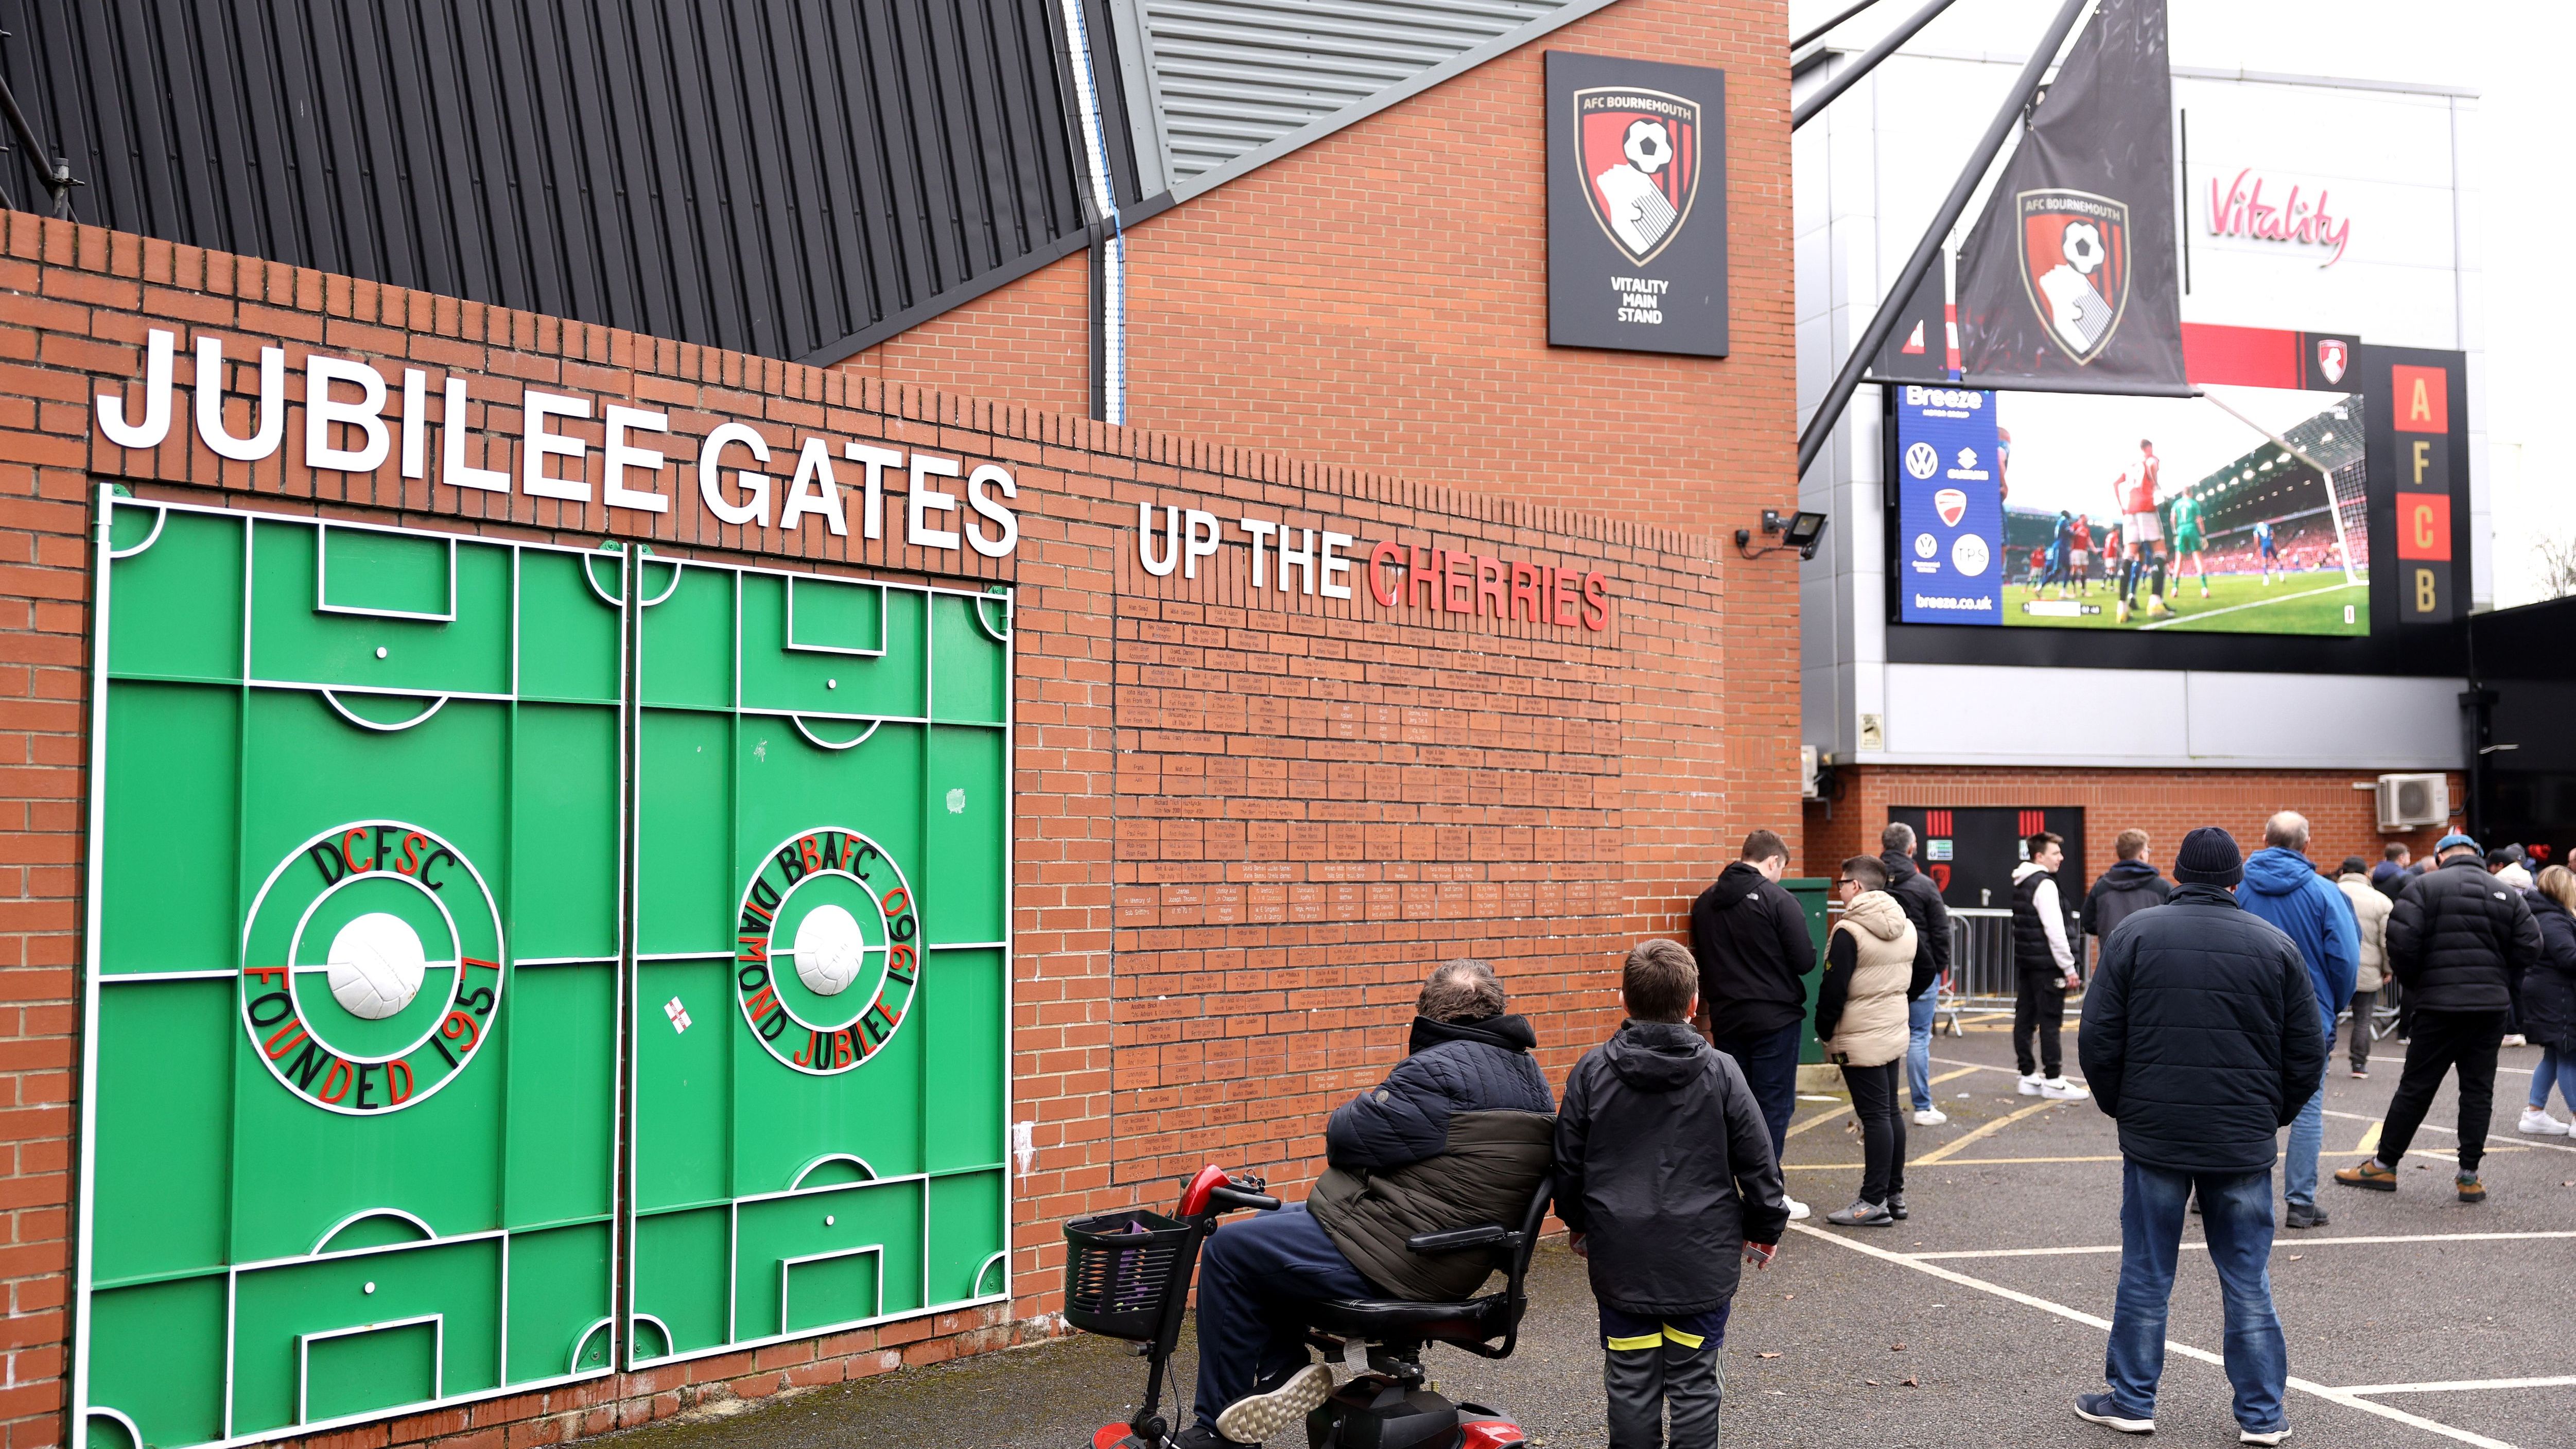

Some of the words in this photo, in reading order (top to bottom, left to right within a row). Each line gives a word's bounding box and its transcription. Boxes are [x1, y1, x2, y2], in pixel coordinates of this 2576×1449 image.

[1583, 96, 1605, 110] AFC
[1607, 96, 1692, 120] BOURNEMOUTH
[2026, 199, 2045, 212] AFC
[2046, 198, 2120, 221] BOURNEMOUTH
[2213, 167, 2349, 267] Vitality
[1611, 276, 1669, 294] VITALITY
[1623, 293, 1657, 308] MAIN
[1618, 308, 1663, 324] STAND
[1907, 385, 1982, 409] Breeze
[97, 328, 668, 513] JUBILEE
[699, 422, 1018, 557] GATES
[1139, 501, 1220, 579] UP
[1241, 517, 1352, 600] THE
[1369, 540, 1609, 631] CHERRIES
[1916, 593, 1992, 610] breeze.co.uk
[309, 825, 455, 890] DCFSC
[776, 831, 877, 886] BBAFC
[881, 887, 916, 985] 1960
[738, 879, 788, 1040] DIAMOND
[794, 990, 902, 1070] JUBILEE
[243, 967, 413, 1109] FOUNDED
[430, 957, 500, 1069] 1957
